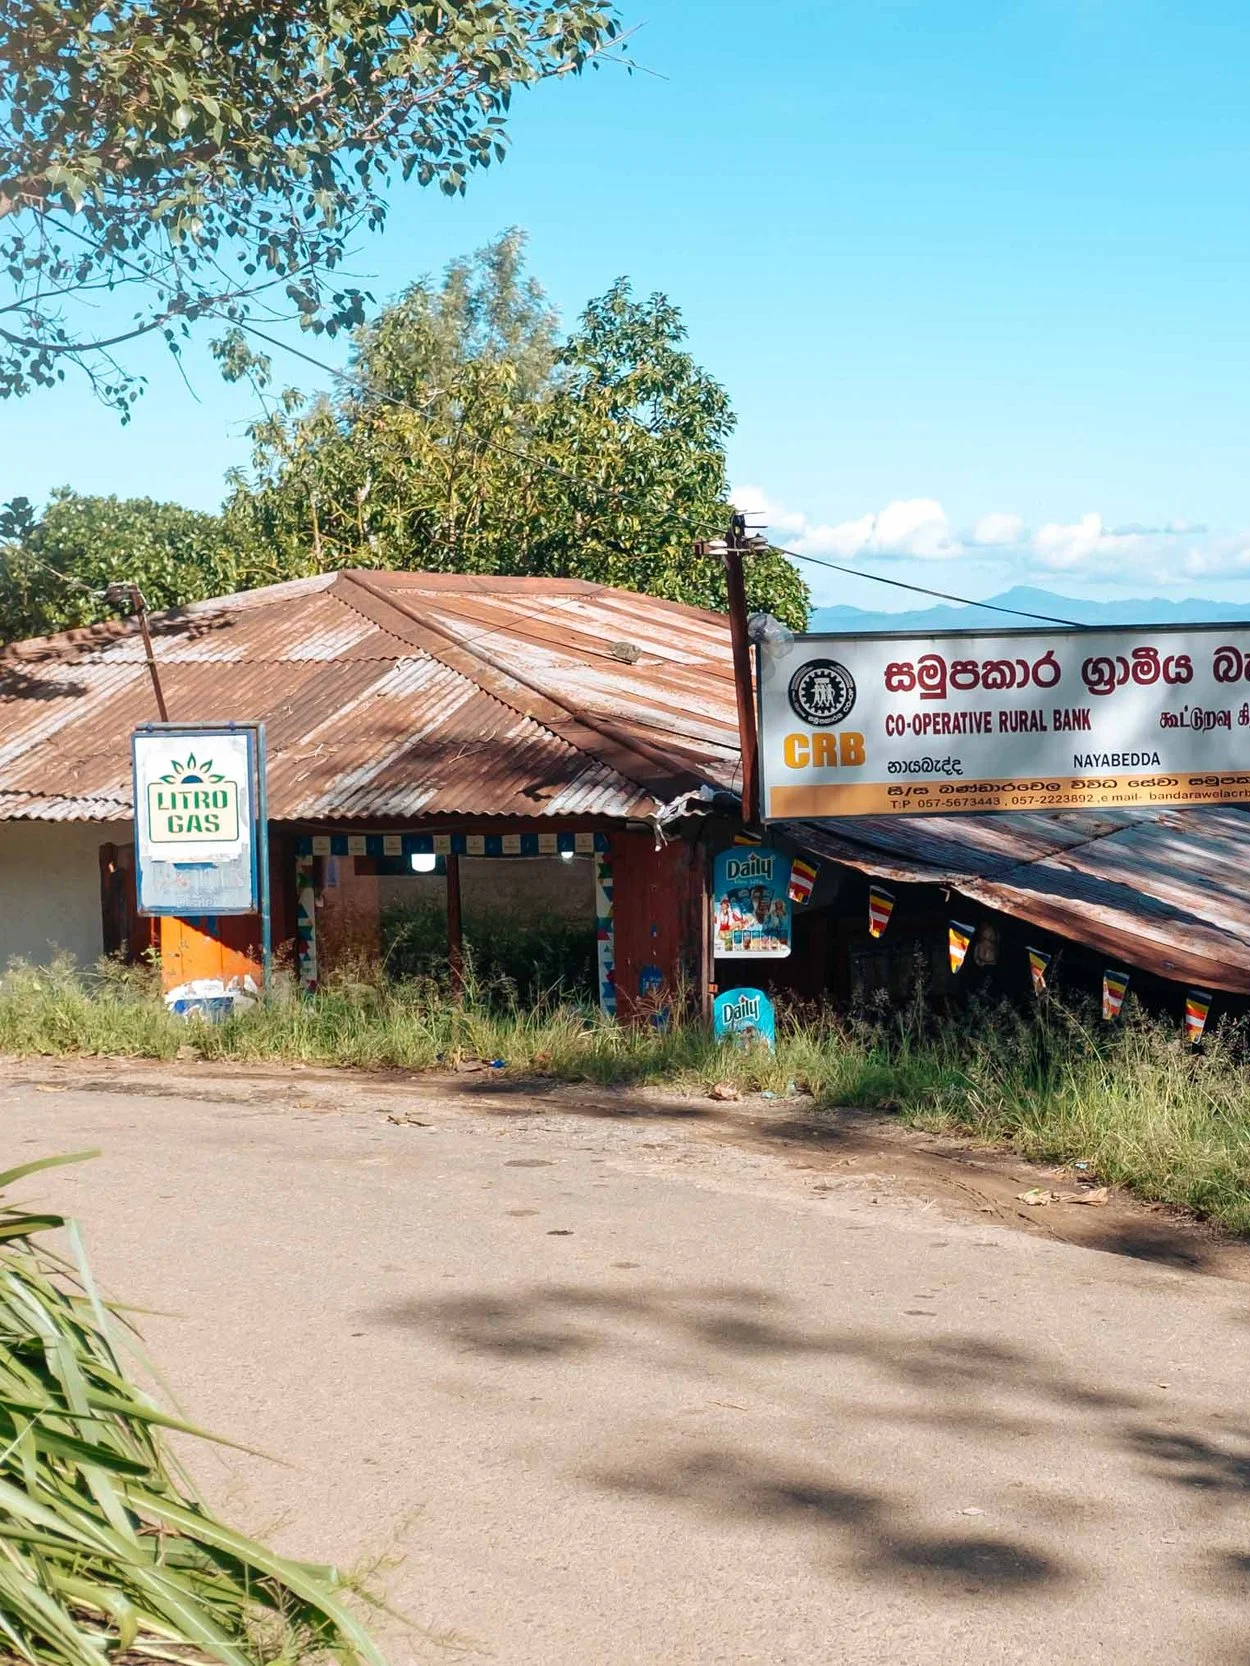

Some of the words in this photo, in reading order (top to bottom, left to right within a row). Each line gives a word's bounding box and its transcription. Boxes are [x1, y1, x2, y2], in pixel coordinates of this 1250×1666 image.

[885, 711, 993, 737] CO-OPERATIVE
[998, 709, 1048, 733] RURAL
[1052, 708, 1092, 732] BANK
[783, 732, 866, 769] CRB
[1073, 751, 1161, 769] NAYABEDDA
[157, 790, 228, 811] LITRO
[918, 797, 1001, 808] 057-5673443
[1011, 794, 1094, 805] 057-2223892
[167, 814, 220, 833] GAS
[726, 852, 774, 880] Daily
[722, 994, 759, 1024] Daily
